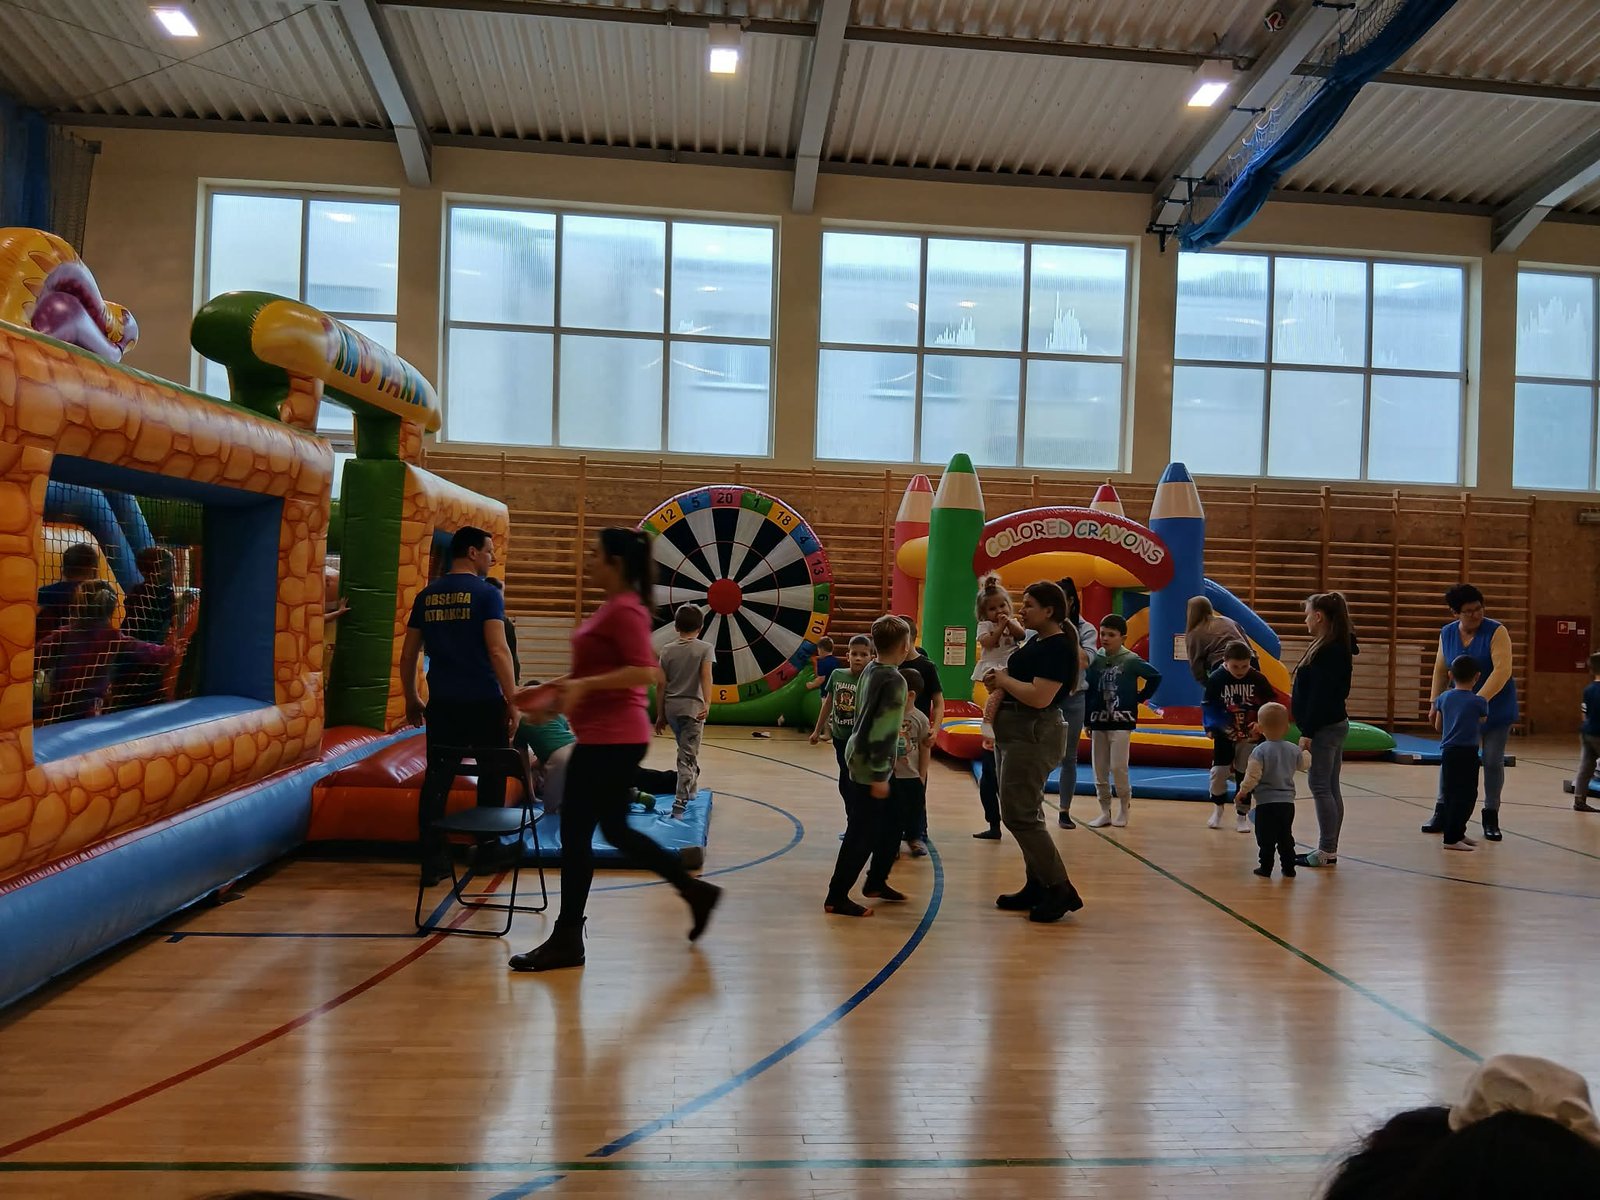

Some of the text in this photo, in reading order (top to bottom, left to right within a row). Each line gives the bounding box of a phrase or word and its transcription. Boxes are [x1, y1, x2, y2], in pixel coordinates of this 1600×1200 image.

[691, 497, 700, 508] 5
[716, 492, 733, 504] 20
[659, 508, 677, 524] 12
[777, 510, 792, 526] 18
[799, 535, 809, 545] 4
[987, 520, 1163, 563] COLORED CRAYONS
[813, 559, 824, 576] 13
[817, 594, 829, 602] 6
[811, 619, 825, 635] 10
[778, 670, 788, 681] 2
[719, 689, 728, 700] 3
[747, 682, 762, 697] 17
[1220, 684, 1255, 698] LAMINE
